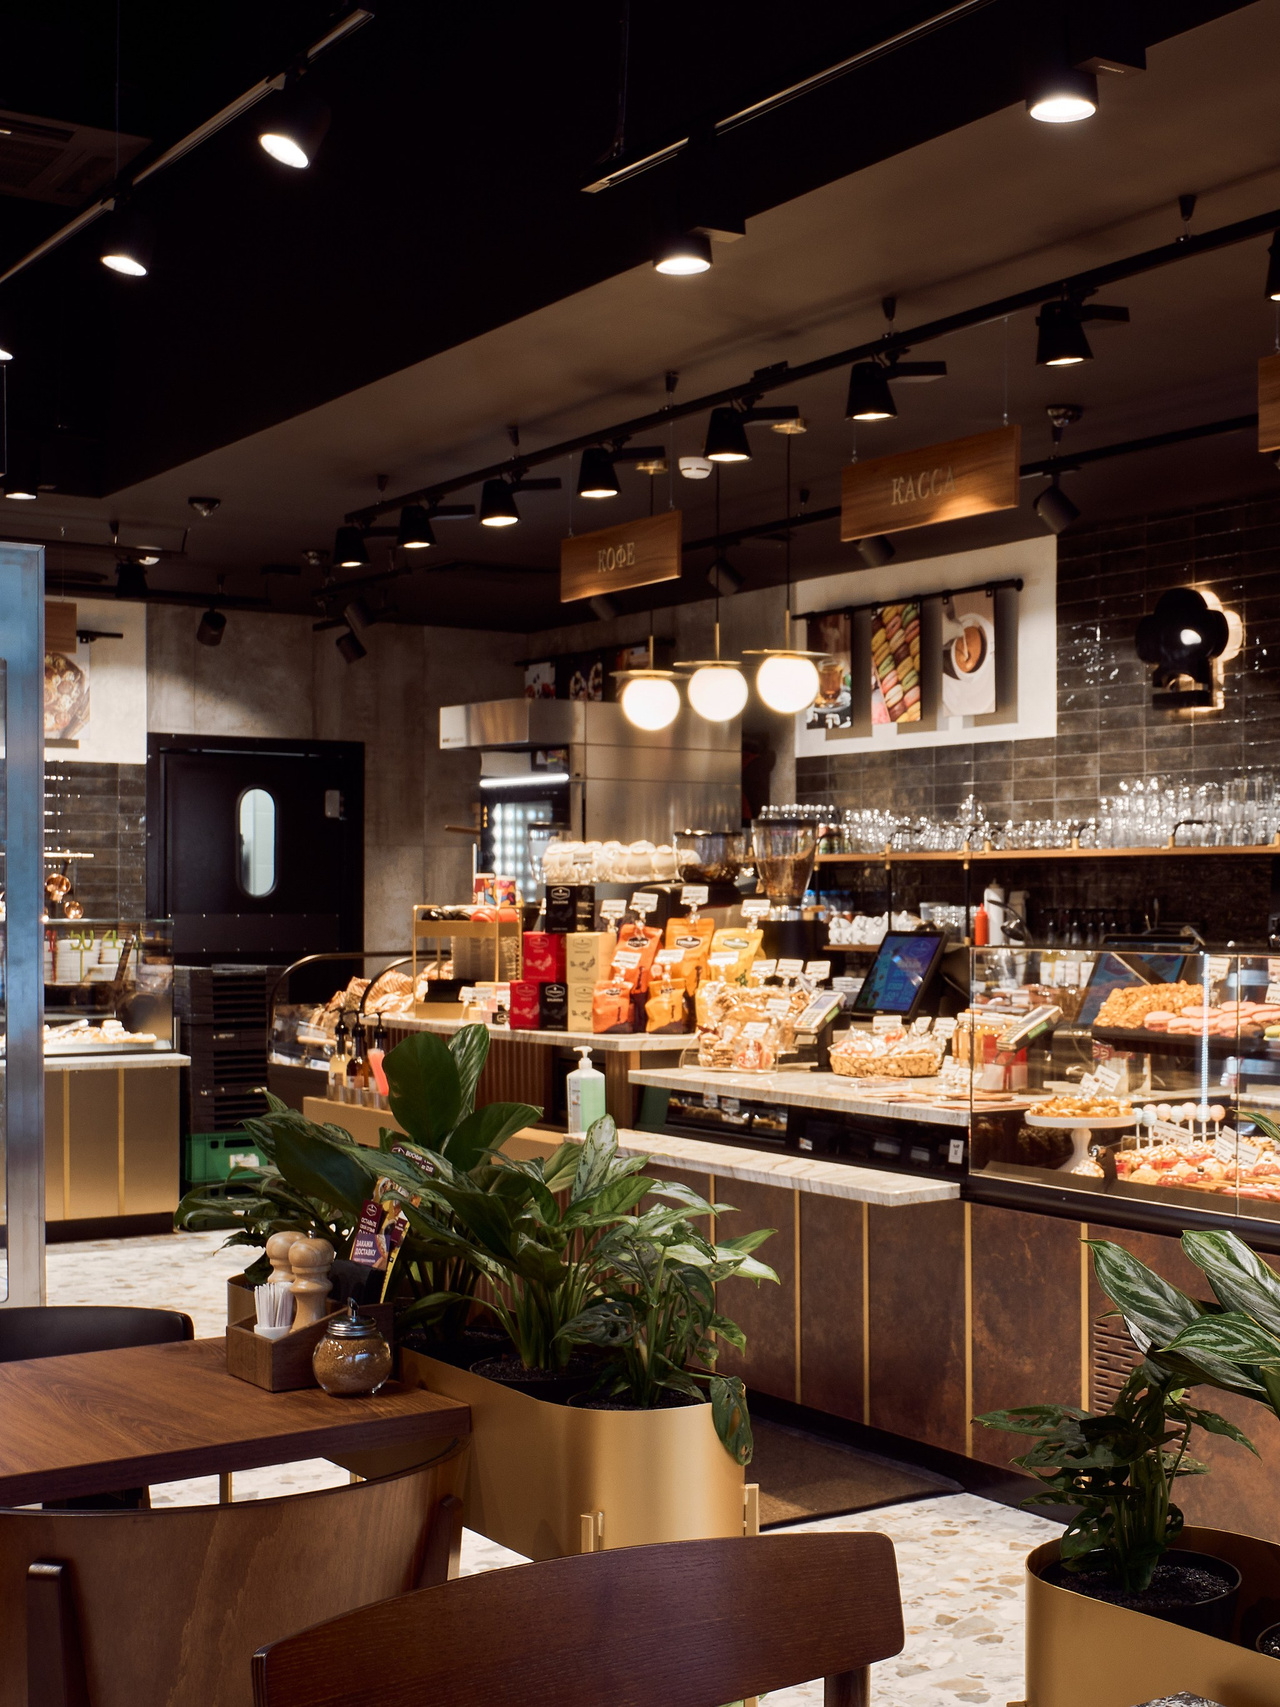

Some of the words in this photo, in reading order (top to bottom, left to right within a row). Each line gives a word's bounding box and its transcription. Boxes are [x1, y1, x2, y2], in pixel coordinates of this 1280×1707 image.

[891, 465, 956, 506] КАССА
[598, 542, 635, 573] КОФЕ
[355, 1247, 376, 1256] ДОСТАВКУ
